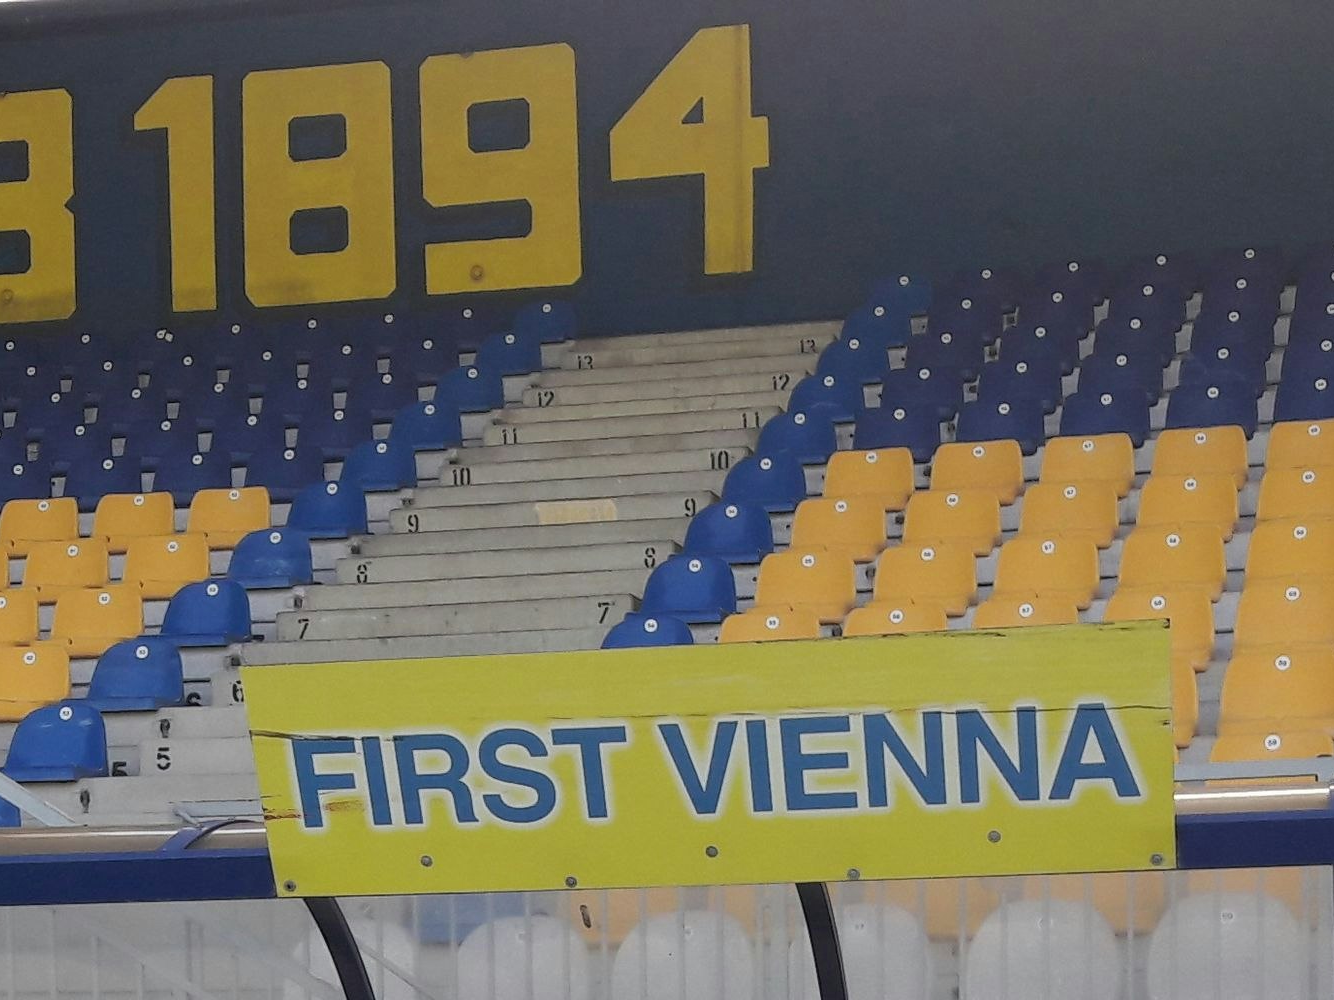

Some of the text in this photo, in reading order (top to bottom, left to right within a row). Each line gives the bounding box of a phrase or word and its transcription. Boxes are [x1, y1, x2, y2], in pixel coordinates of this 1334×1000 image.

[136, 29, 767, 310] 1894
[772, 373, 790, 391] 12
[710, 450, 729, 470] 10
[453, 467, 471, 486] 10
[685, 498, 696, 517] 9
[408, 514, 419, 533] 9
[644, 547, 656, 568] 8
[357, 564, 367, 583] 8
[598, 602, 613, 624] 7
[298, 618, 309, 639] 7
[157, 747, 171, 770] 5
[290, 702, 1142, 829] FIRST VIENNA
